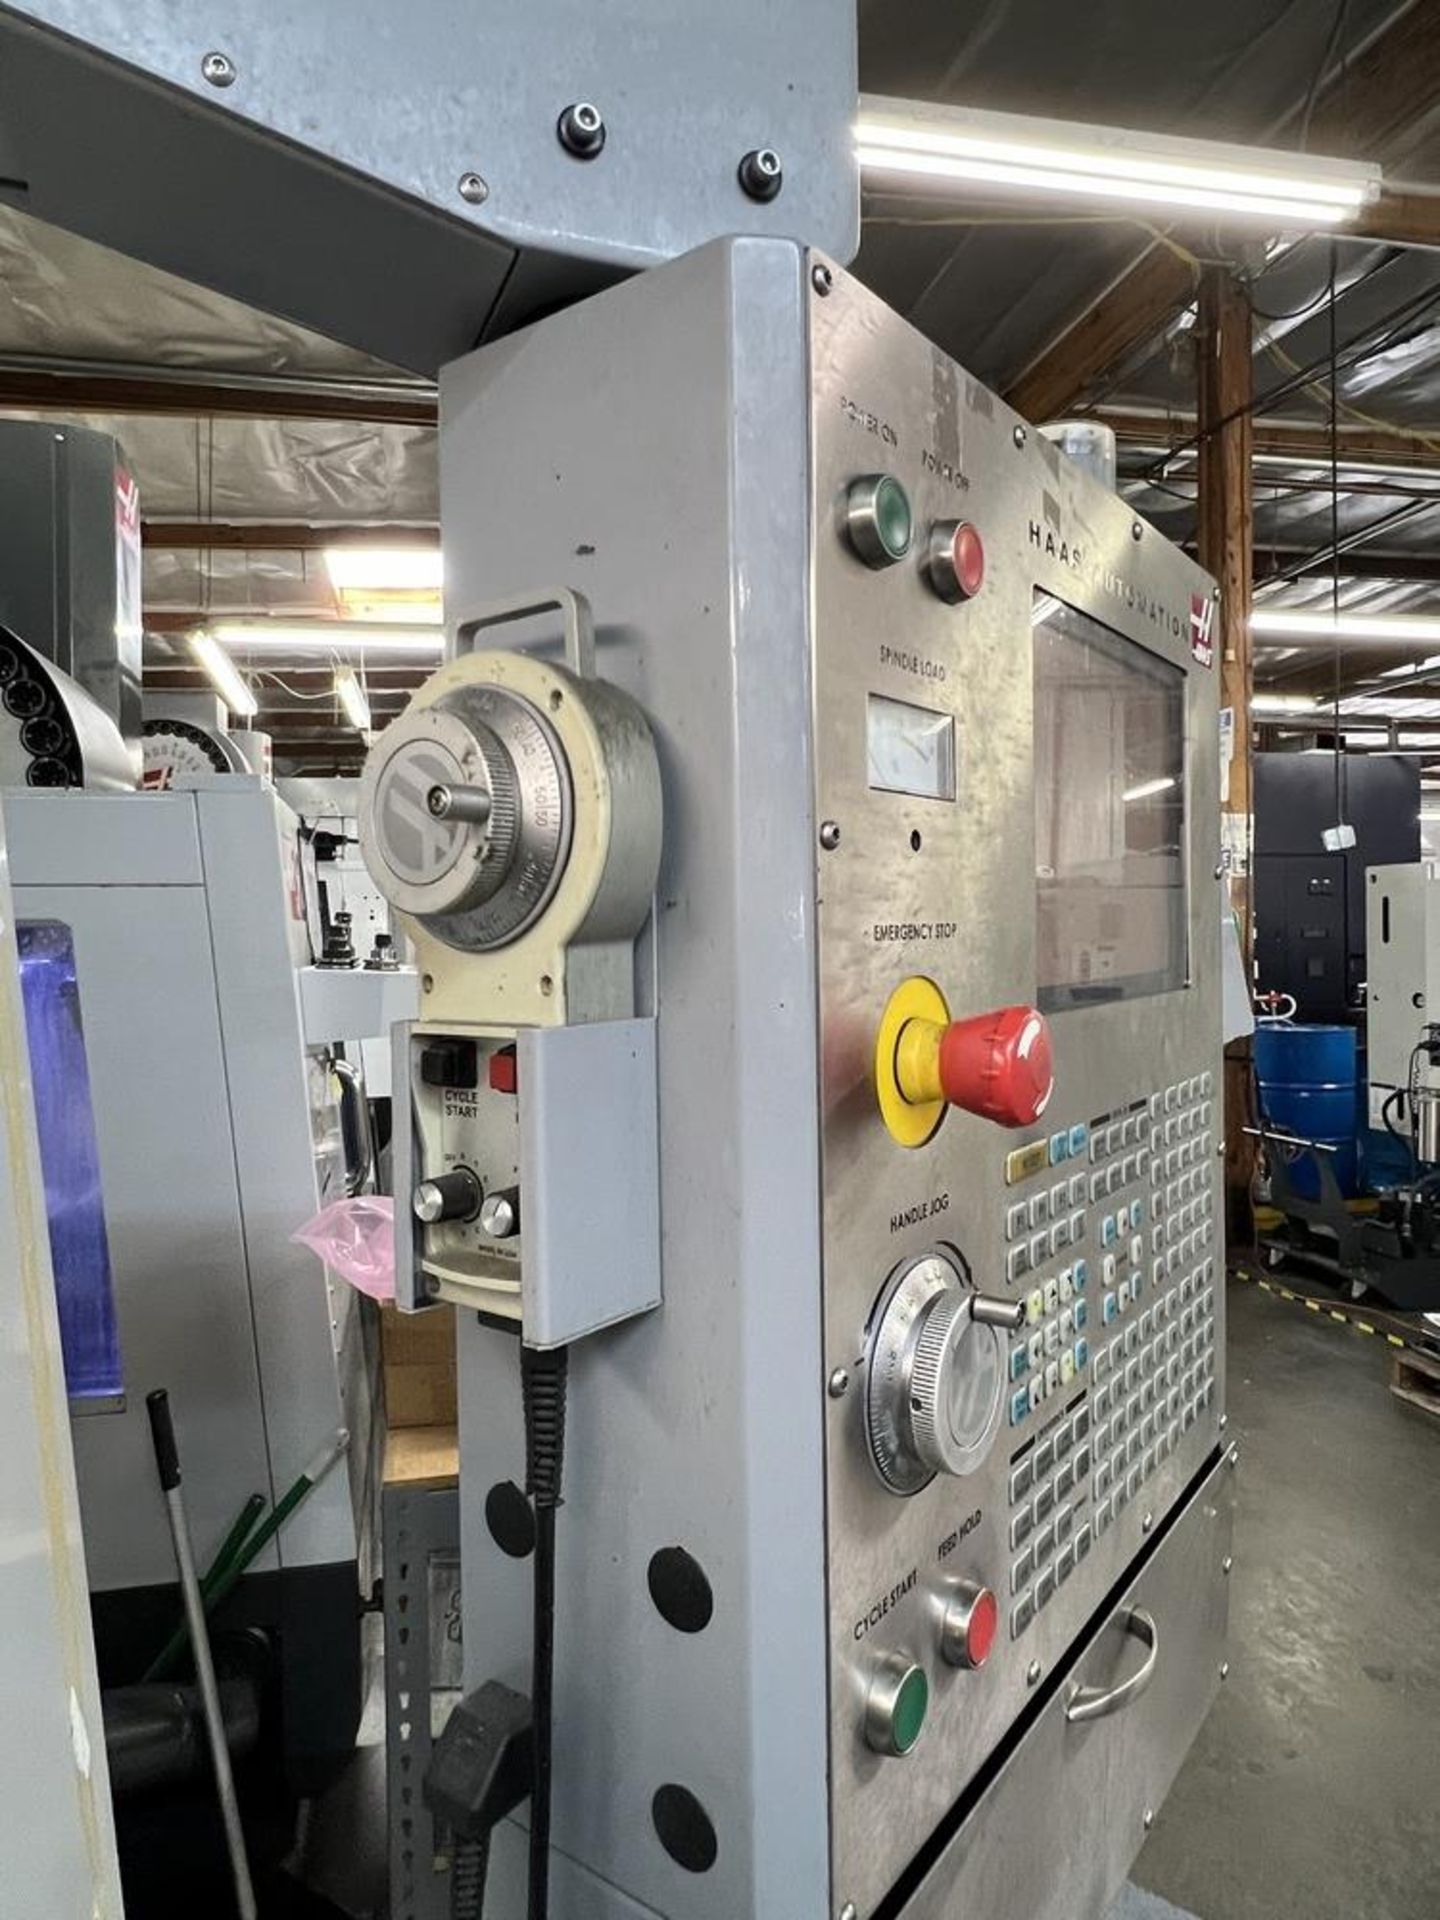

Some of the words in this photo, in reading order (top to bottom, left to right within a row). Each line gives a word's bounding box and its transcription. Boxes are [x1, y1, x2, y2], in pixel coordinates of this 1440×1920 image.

[1029, 520, 1081, 567] HAAS
[880, 645, 918, 675] SPINDLE
[920, 660, 945, 682] LOAD
[874, 925, 933, 941] EMERGENCY
[935, 923, 957, 938] STOP
[445, 1091, 478, 1104] CYCLE
[446, 1104, 478, 1118] START
[890, 1203, 927, 1232] HANDLE
[928, 1194, 949, 1216] JOG
[938, 1532, 957, 1561] FEED
[958, 1509, 982, 1542] HOLD
[854, 1597, 888, 1641] CYCLE
[889, 1568, 918, 1608] START
